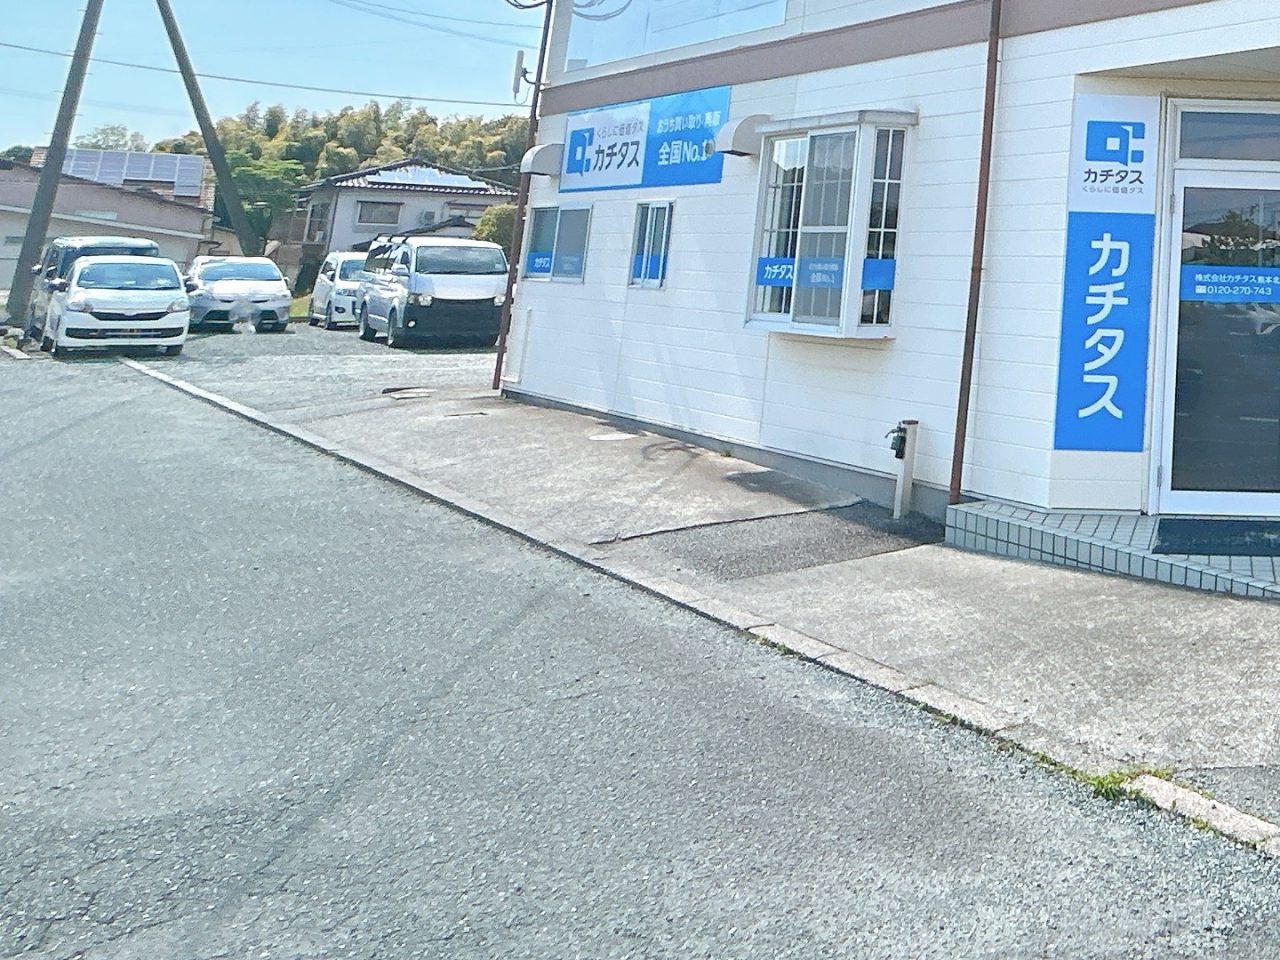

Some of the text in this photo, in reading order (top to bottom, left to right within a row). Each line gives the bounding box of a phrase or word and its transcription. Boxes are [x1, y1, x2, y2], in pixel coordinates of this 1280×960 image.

[593, 141, 640, 171] カチタス
[658, 139, 708, 165] 全国No.1
[1083, 168, 1144, 184] カチタス
[764, 264, 793, 280] カチタス
[1207, 285, 1272, 296] 0120-270-743
[1078, 232, 1130, 419] カチタス
